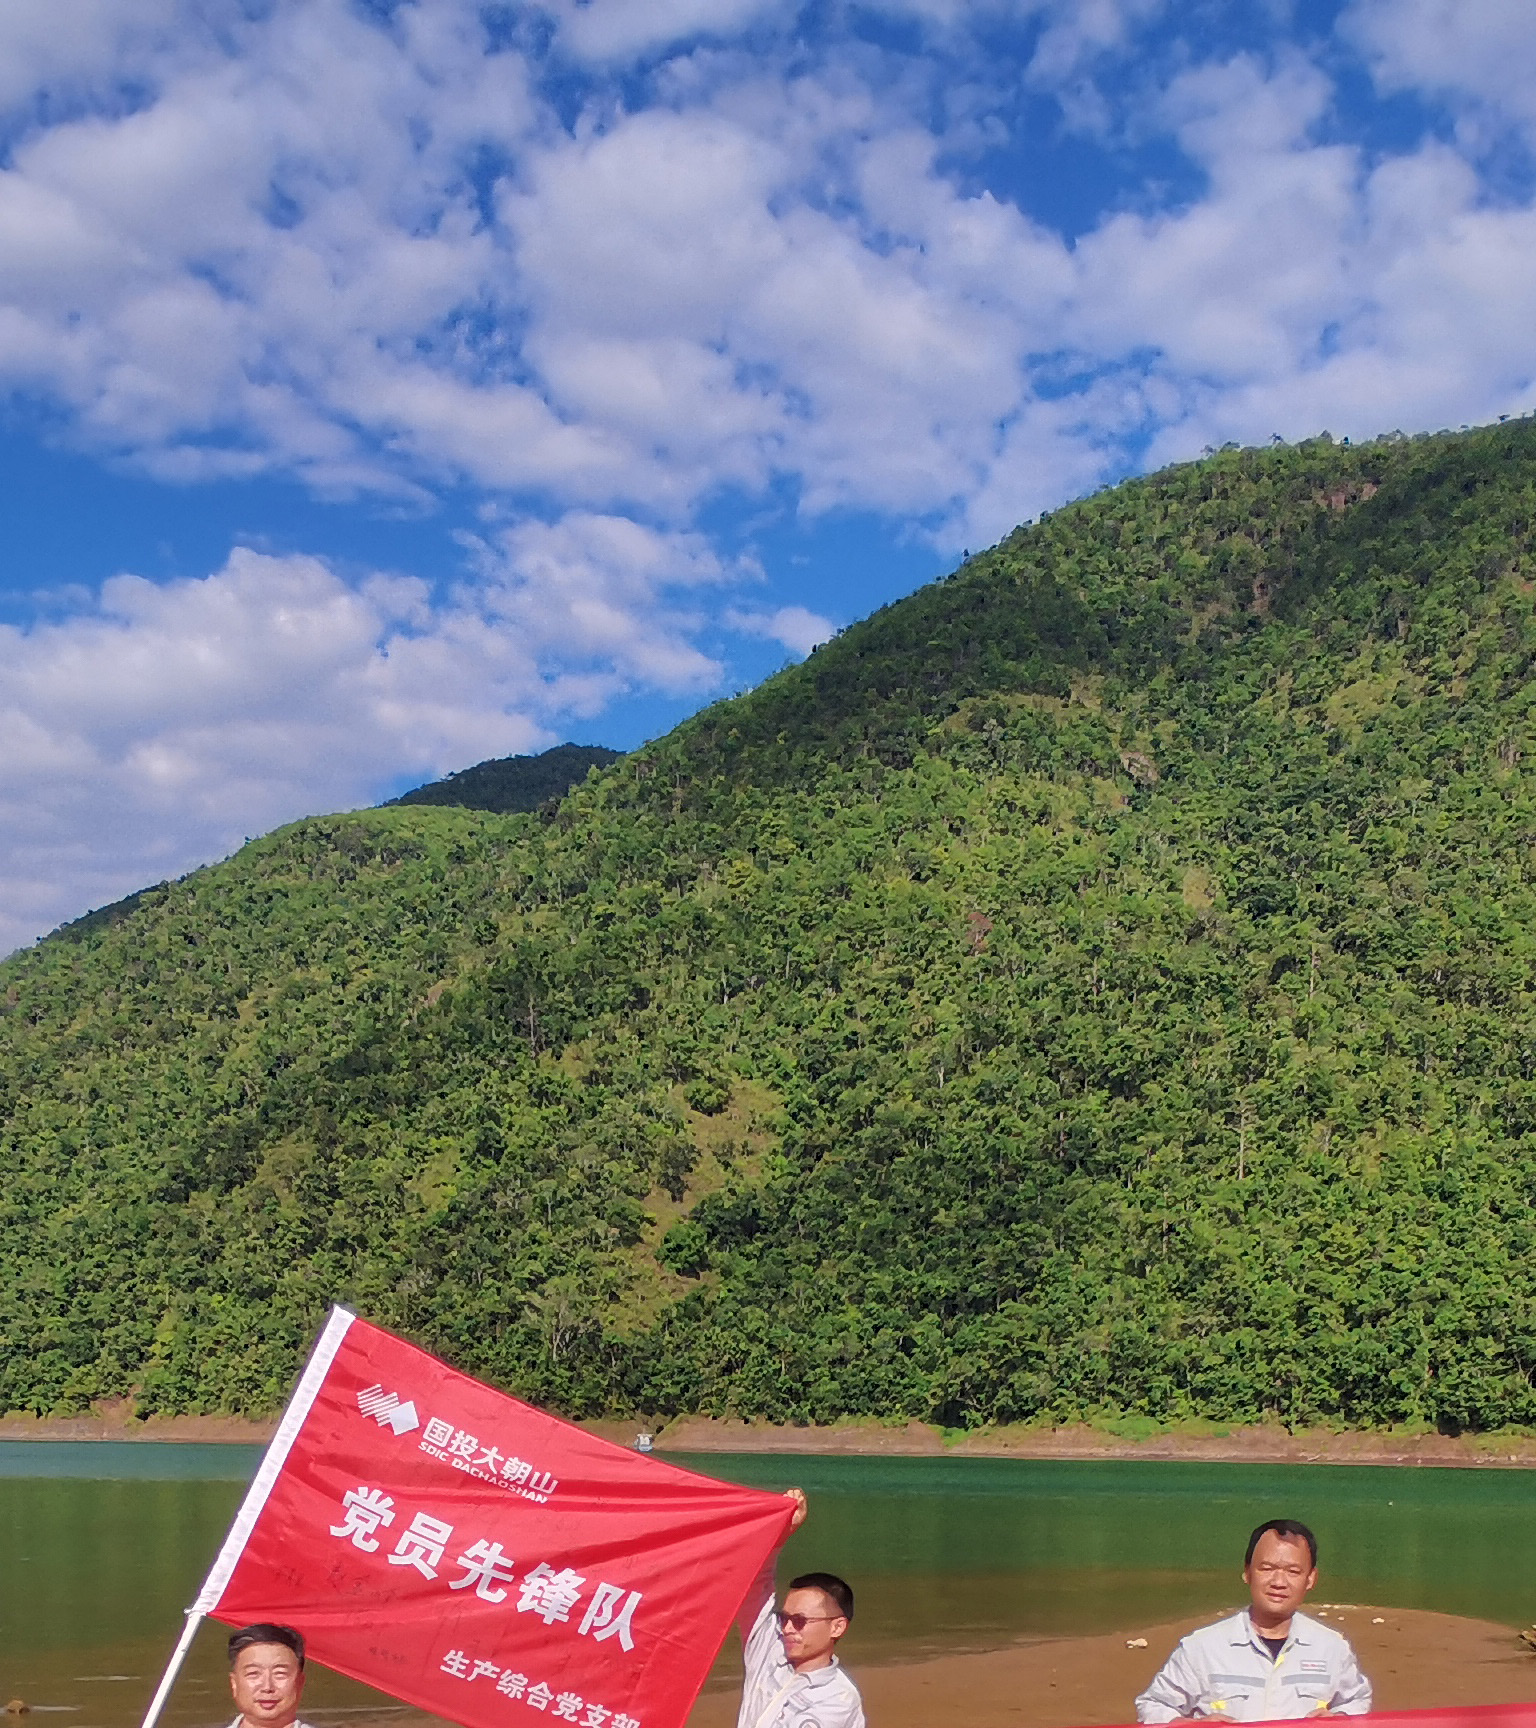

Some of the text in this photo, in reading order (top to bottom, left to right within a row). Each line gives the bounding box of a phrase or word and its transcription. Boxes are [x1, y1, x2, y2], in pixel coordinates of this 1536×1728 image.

[418, 1441, 548, 1503] SDIC DACHAOSHAN
[423, 1417, 558, 1494] 国投大朝山
[330, 1486, 642, 1652] 党员先锋队
